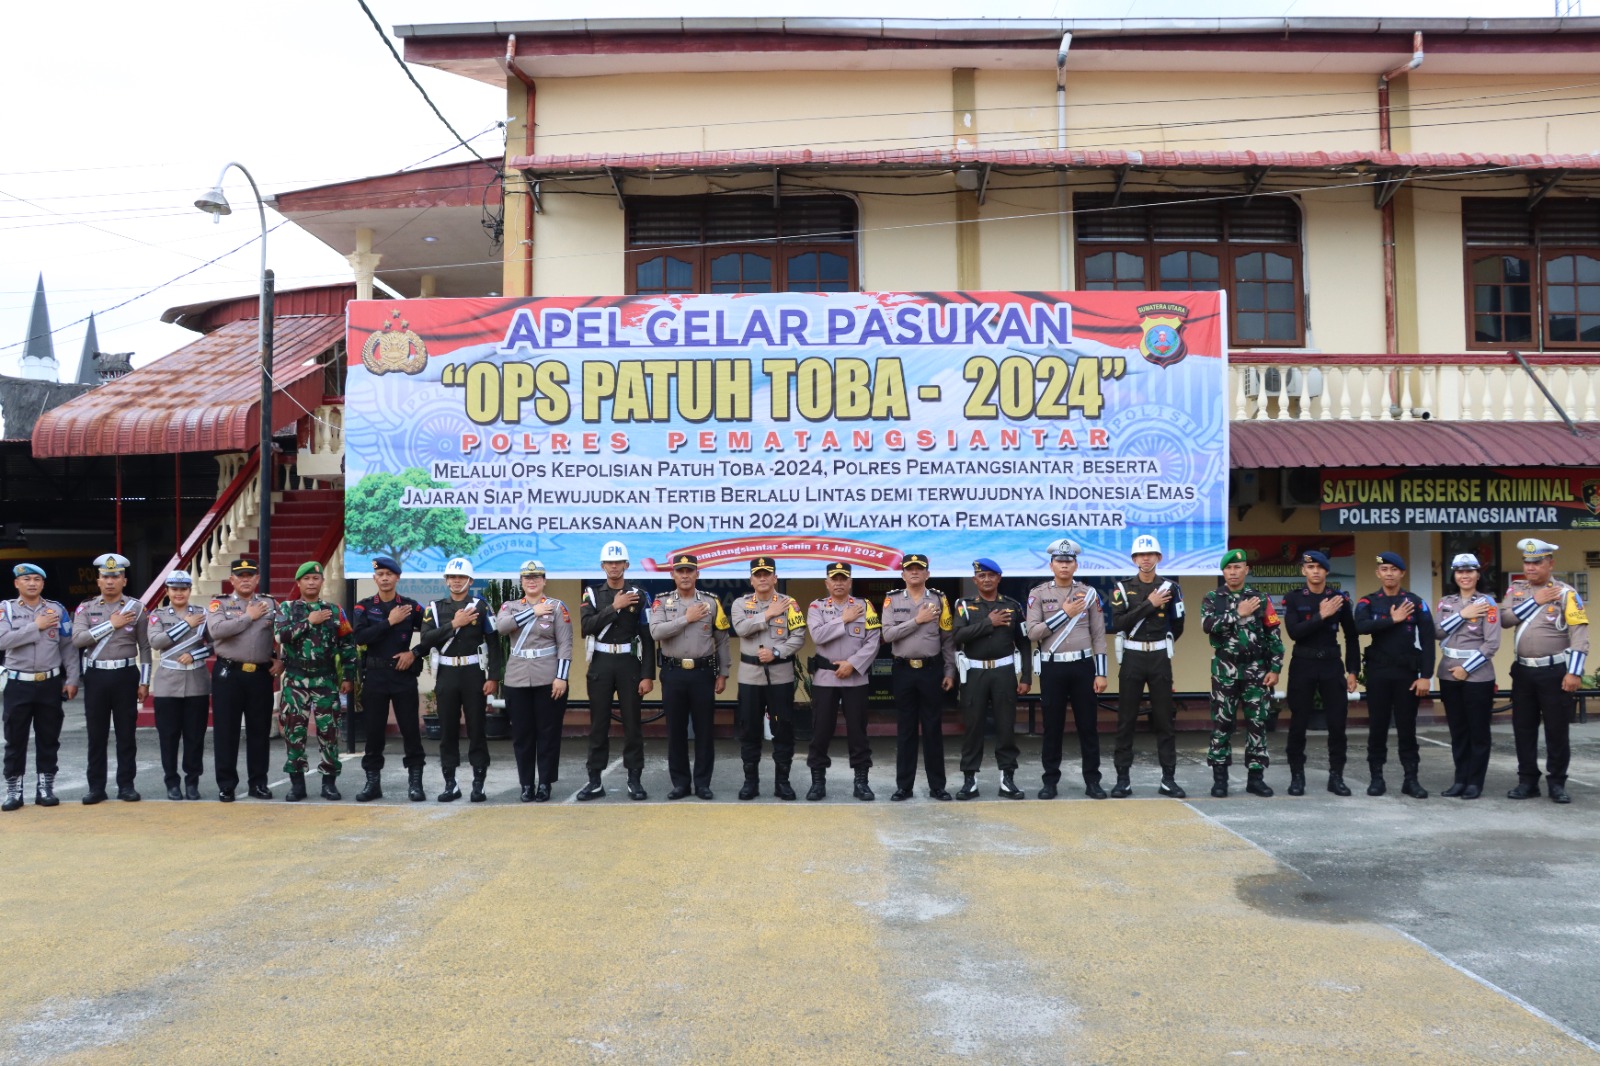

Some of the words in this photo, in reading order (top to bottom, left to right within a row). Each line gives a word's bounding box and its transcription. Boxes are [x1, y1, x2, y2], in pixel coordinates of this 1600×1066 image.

[1137, 304, 1166, 313] SUMATERA
[1167, 304, 1185, 313] UTARA
[503, 310, 631, 349] APEL
[645, 309, 809, 347] GELAR
[828, 306, 1070, 345] PASUKAN
[582, 358, 753, 424] PATUH
[762, 356, 911, 421] TOBA
[1113, 406, 1194, 430] POLISI
[461, 432, 631, 455] POLRES
[667, 429, 1111, 454] PEMATANGSIANTAR
[1083, 460, 1158, 474] BESERTA
[871, 488, 912, 501] DEMI
[917, 487, 1044, 501] TERWUJUDNYA
[1323, 479, 1395, 503] SATUAN
[1401, 479, 1481, 502] RESERSE
[1487, 479, 1574, 502] KRIMINAL
[468, 517, 533, 531] JELANG
[537, 516, 662, 530] PELAKSANAAN
[709, 516, 744, 529] THN
[749, 513, 798, 529] 2024
[803, 515, 819, 529] DI
[907, 514, 951, 528] KOTA
[1339, 508, 1400, 524] POLRES
[1405, 507, 1558, 524] PEMATANGSIANTAR
[608, 545, 623, 556] PM
[697, 543, 778, 561] ematangsiantar
[781, 542, 811, 551] Senin
[815, 543, 828, 551] 15
[832, 544, 851, 554] Juli
[854, 547, 885, 560] 2024
